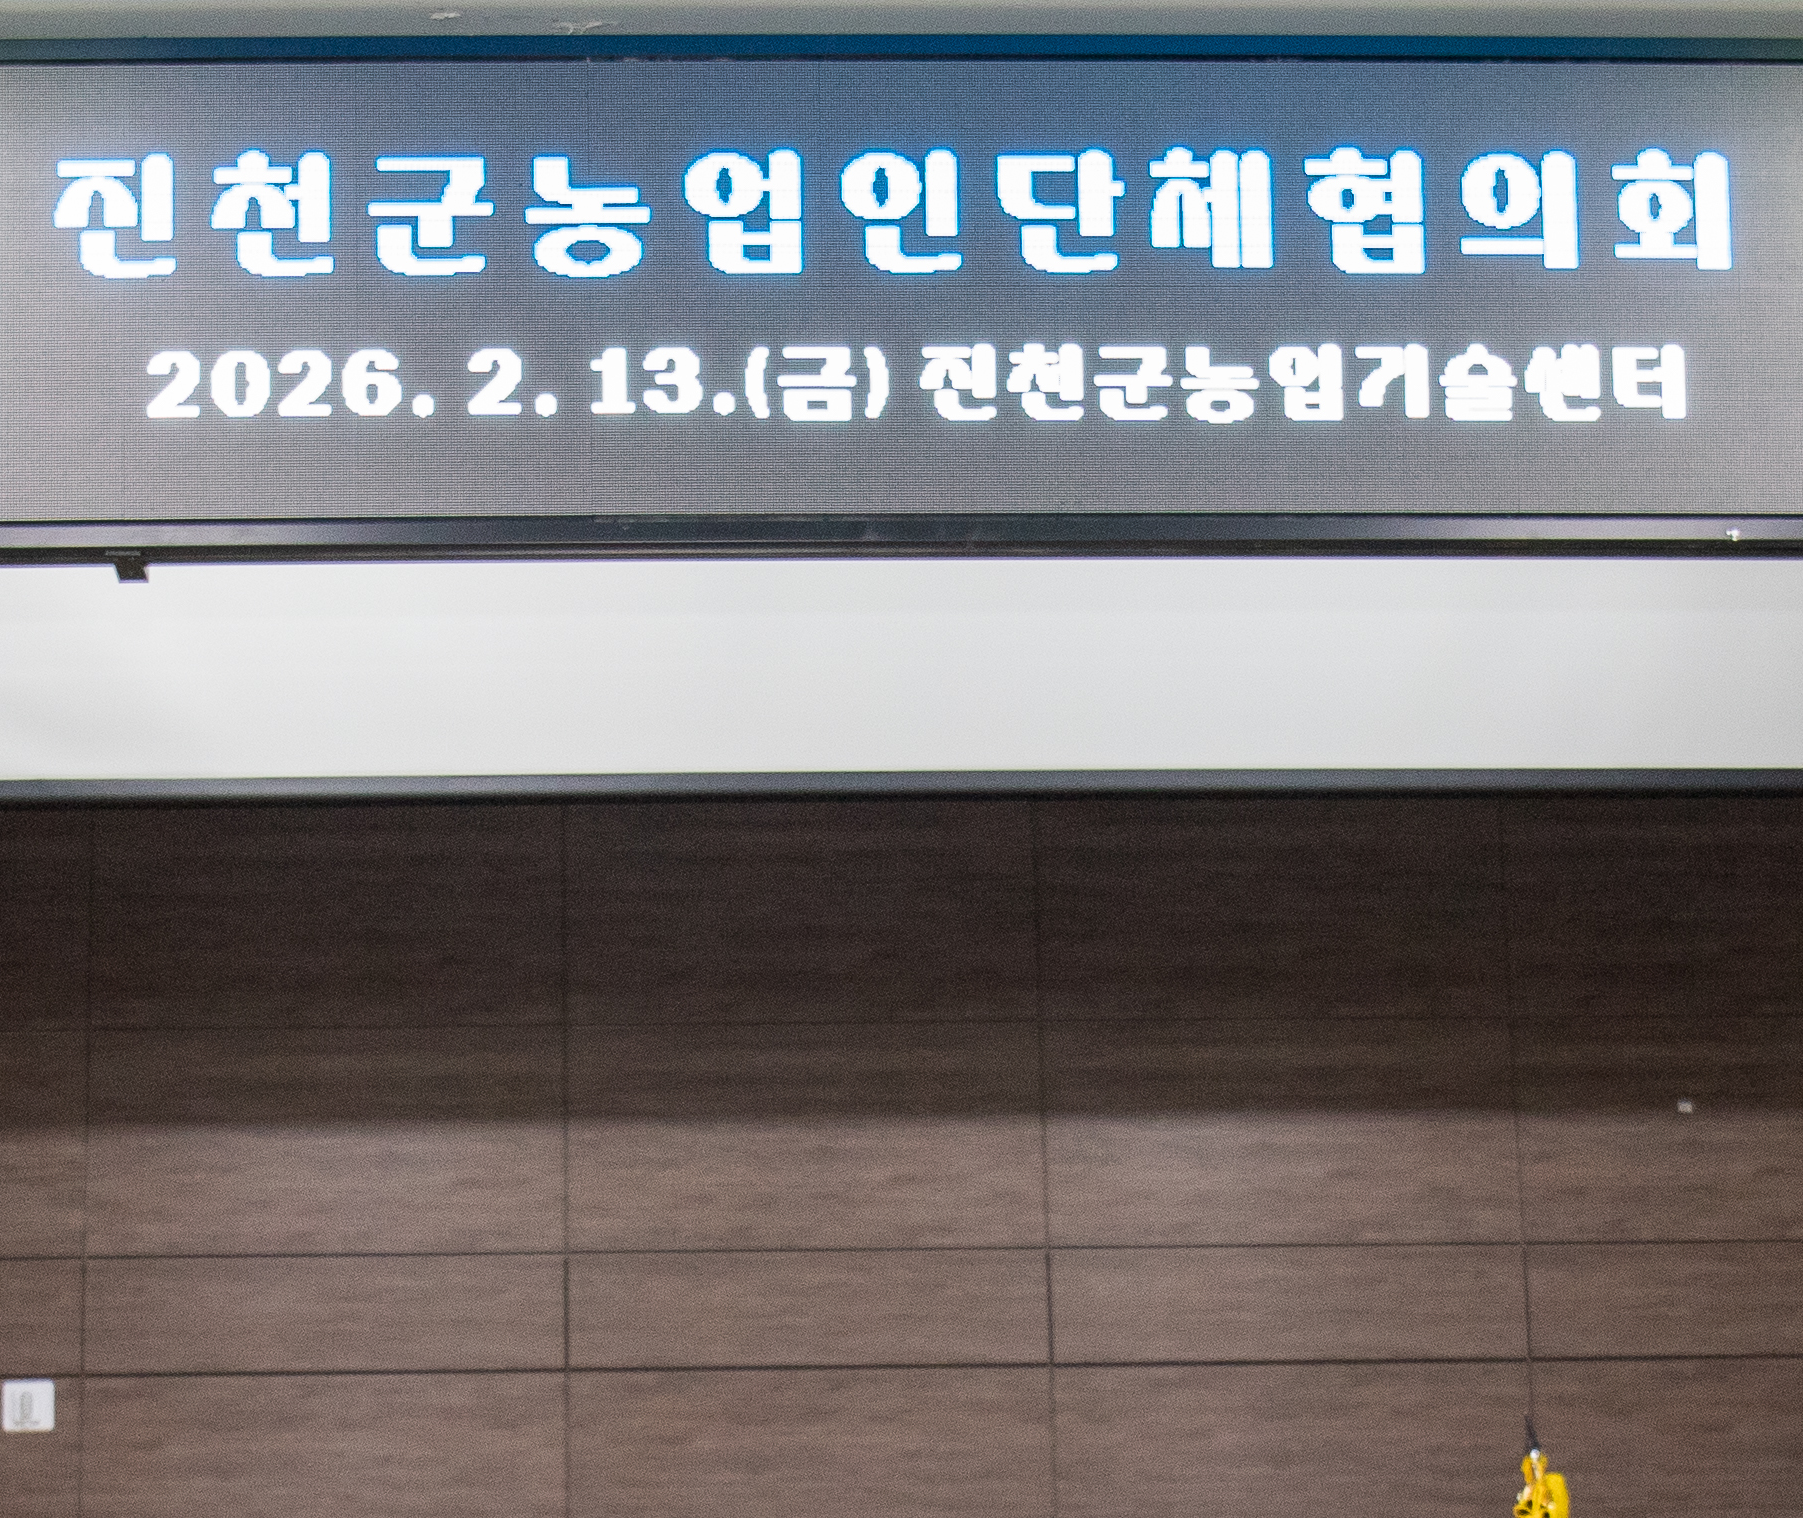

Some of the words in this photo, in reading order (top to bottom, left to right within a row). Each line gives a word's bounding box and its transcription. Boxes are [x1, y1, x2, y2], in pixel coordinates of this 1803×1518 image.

[52, 147, 1732, 280] 진천군농업인단체협의회
[145, 348, 436, 420] 2026.
[466, 347, 559, 418] 2.
[589, 344, 891, 423] 13.(금)
[918, 342, 1688, 425] 진천군농업기술센터
